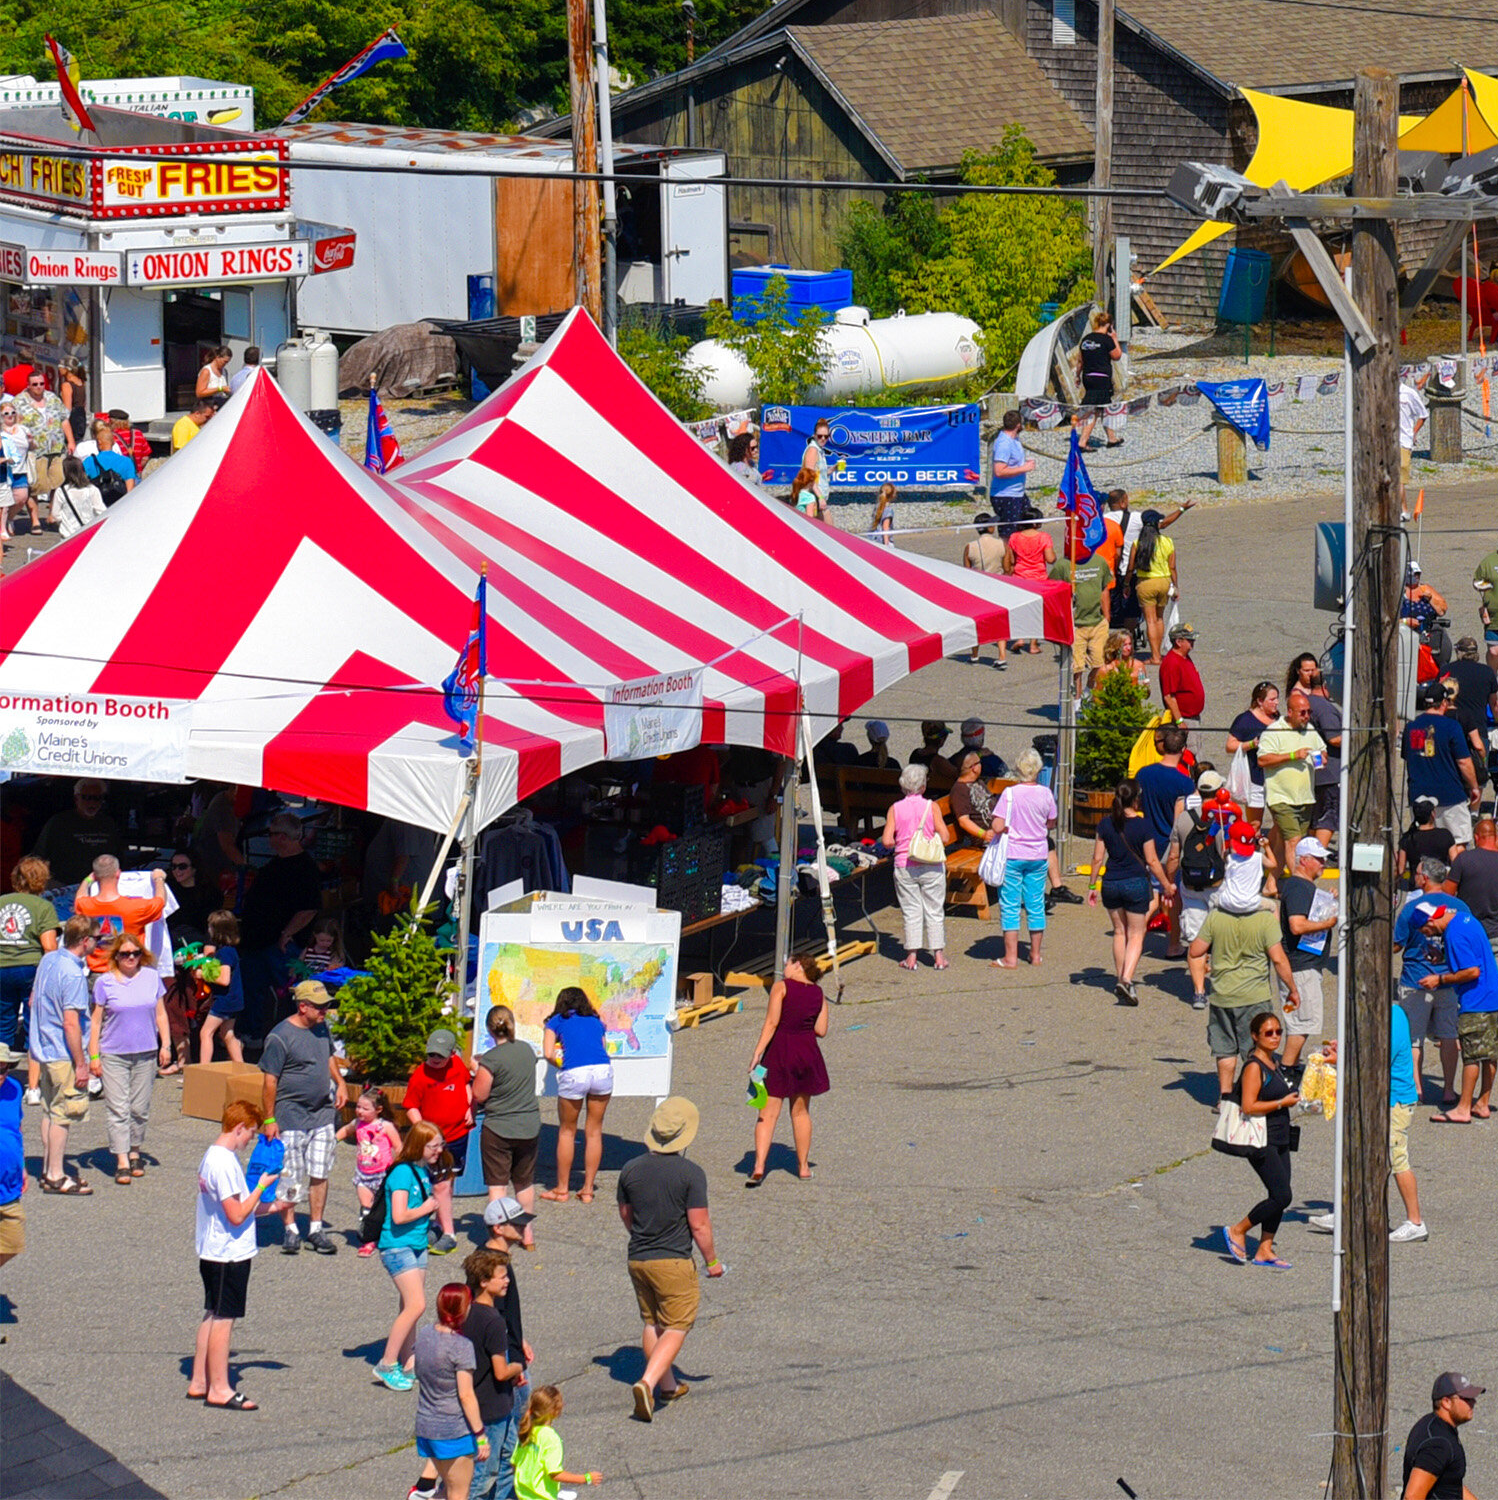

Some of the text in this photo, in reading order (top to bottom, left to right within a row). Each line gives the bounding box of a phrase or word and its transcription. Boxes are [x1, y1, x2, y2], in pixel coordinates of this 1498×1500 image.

[128, 103, 169, 112] ITALIAN
[31, 156, 86, 200] FRIES
[106, 155, 280, 198] FRESH FRIES
[117, 181, 144, 198] CUT
[29, 255, 69, 278] Onion
[74, 257, 119, 282] Rings
[142, 250, 211, 281] ONION
[220, 246, 294, 277] RINGS
[829, 424, 933, 447] OYSTER BAR
[832, 470, 958, 482] ICE COLD BEER
[612, 671, 693, 703] Information Booth
[104, 698, 170, 720] Booth
[36, 715, 99, 729] Sponsored by
[38, 732, 88, 749] Maine's
[38, 747, 128, 767] Credit Unions
[586, 903, 601, 911] YOU
[560, 918, 625, 942] USA
